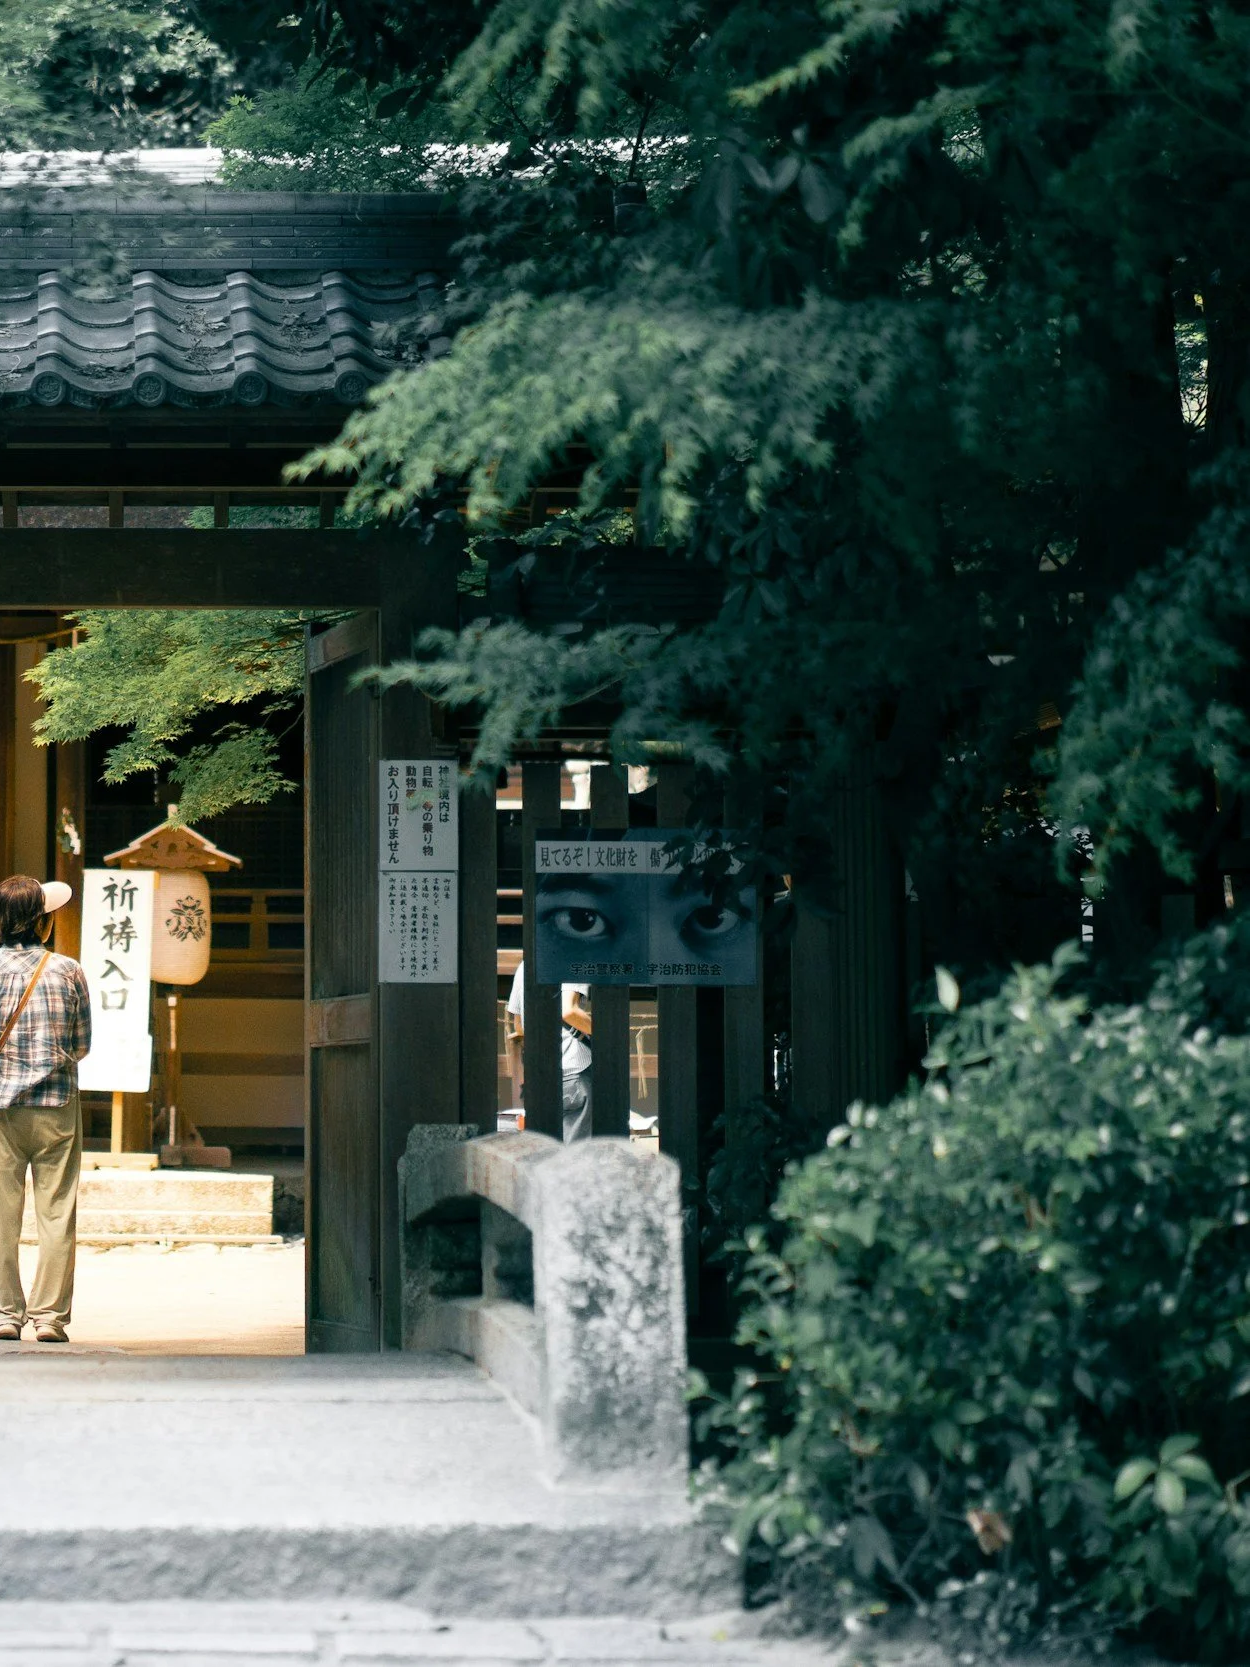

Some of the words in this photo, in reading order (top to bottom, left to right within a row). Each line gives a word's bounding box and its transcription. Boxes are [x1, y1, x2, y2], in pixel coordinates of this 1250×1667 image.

[387, 765, 400, 864] お入り頂けません
[100, 876, 139, 1011] 祈祷入口
